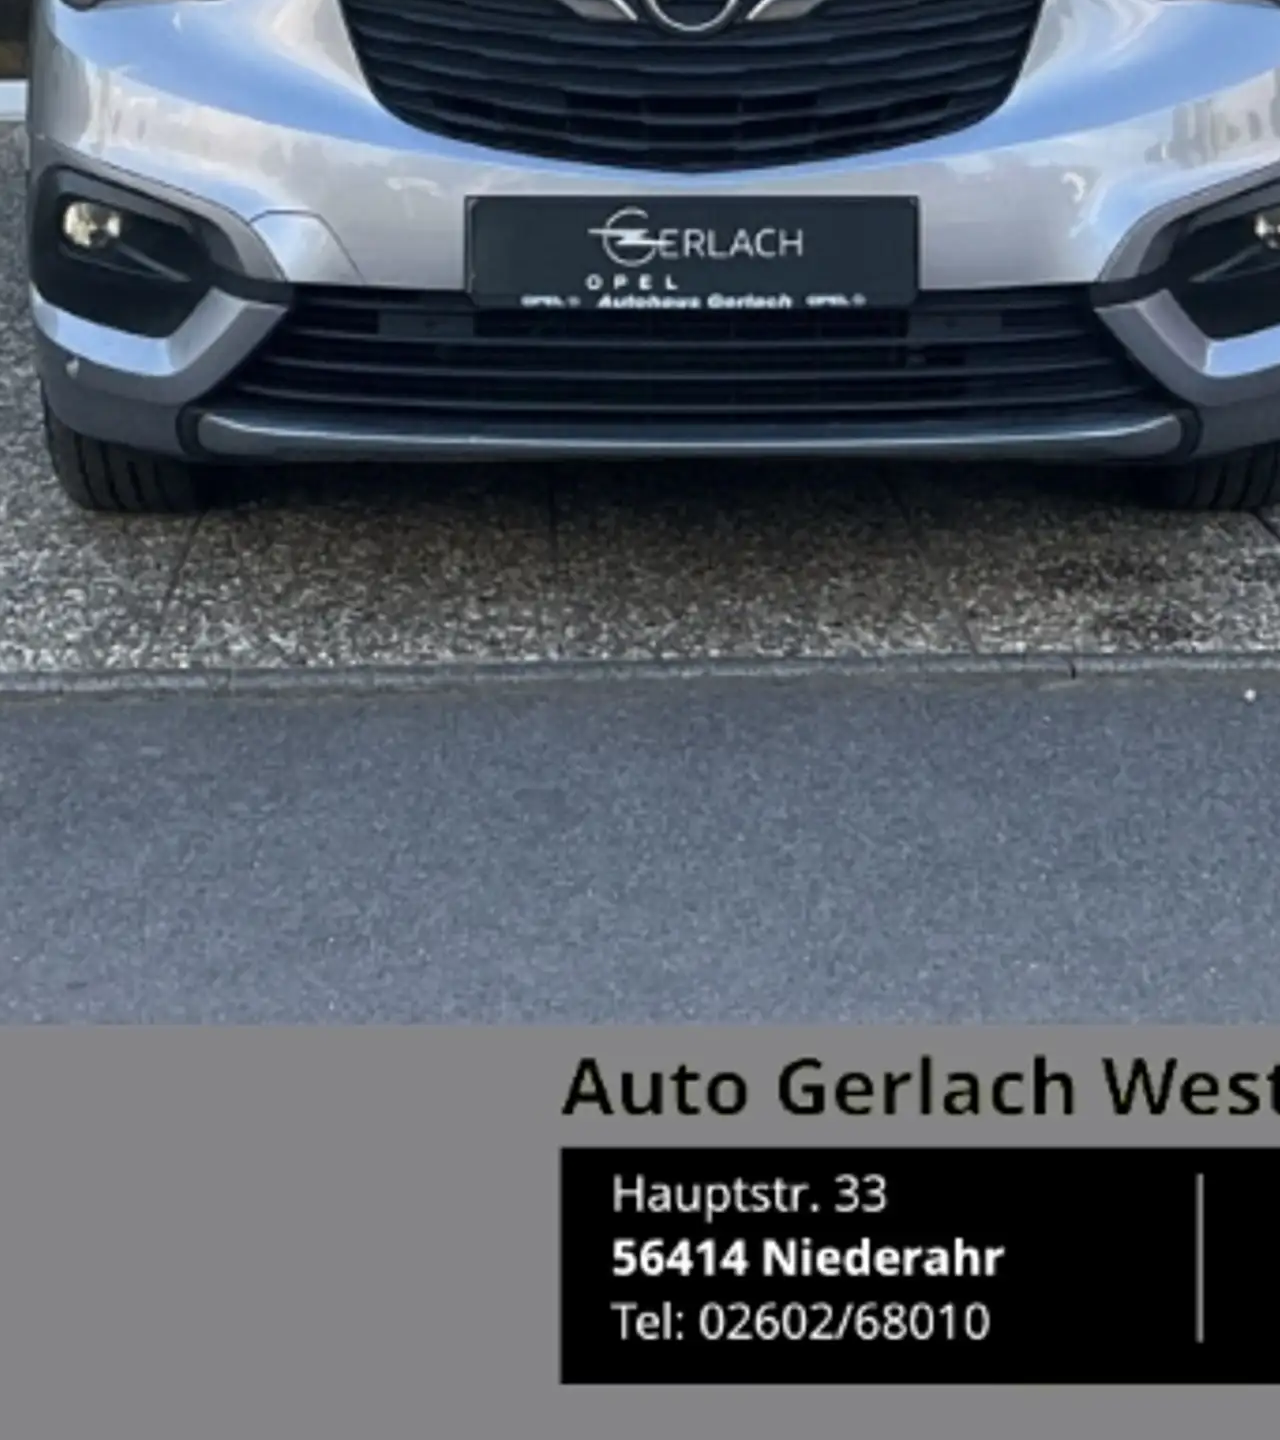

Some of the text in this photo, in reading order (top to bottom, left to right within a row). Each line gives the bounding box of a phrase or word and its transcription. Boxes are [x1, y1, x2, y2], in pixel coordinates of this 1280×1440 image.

[588, 207, 804, 267] GERLACH
[585, 273, 679, 291] OPEL
[597, 293, 701, 309] Autohaus
[706, 293, 793, 309] Gerlach
